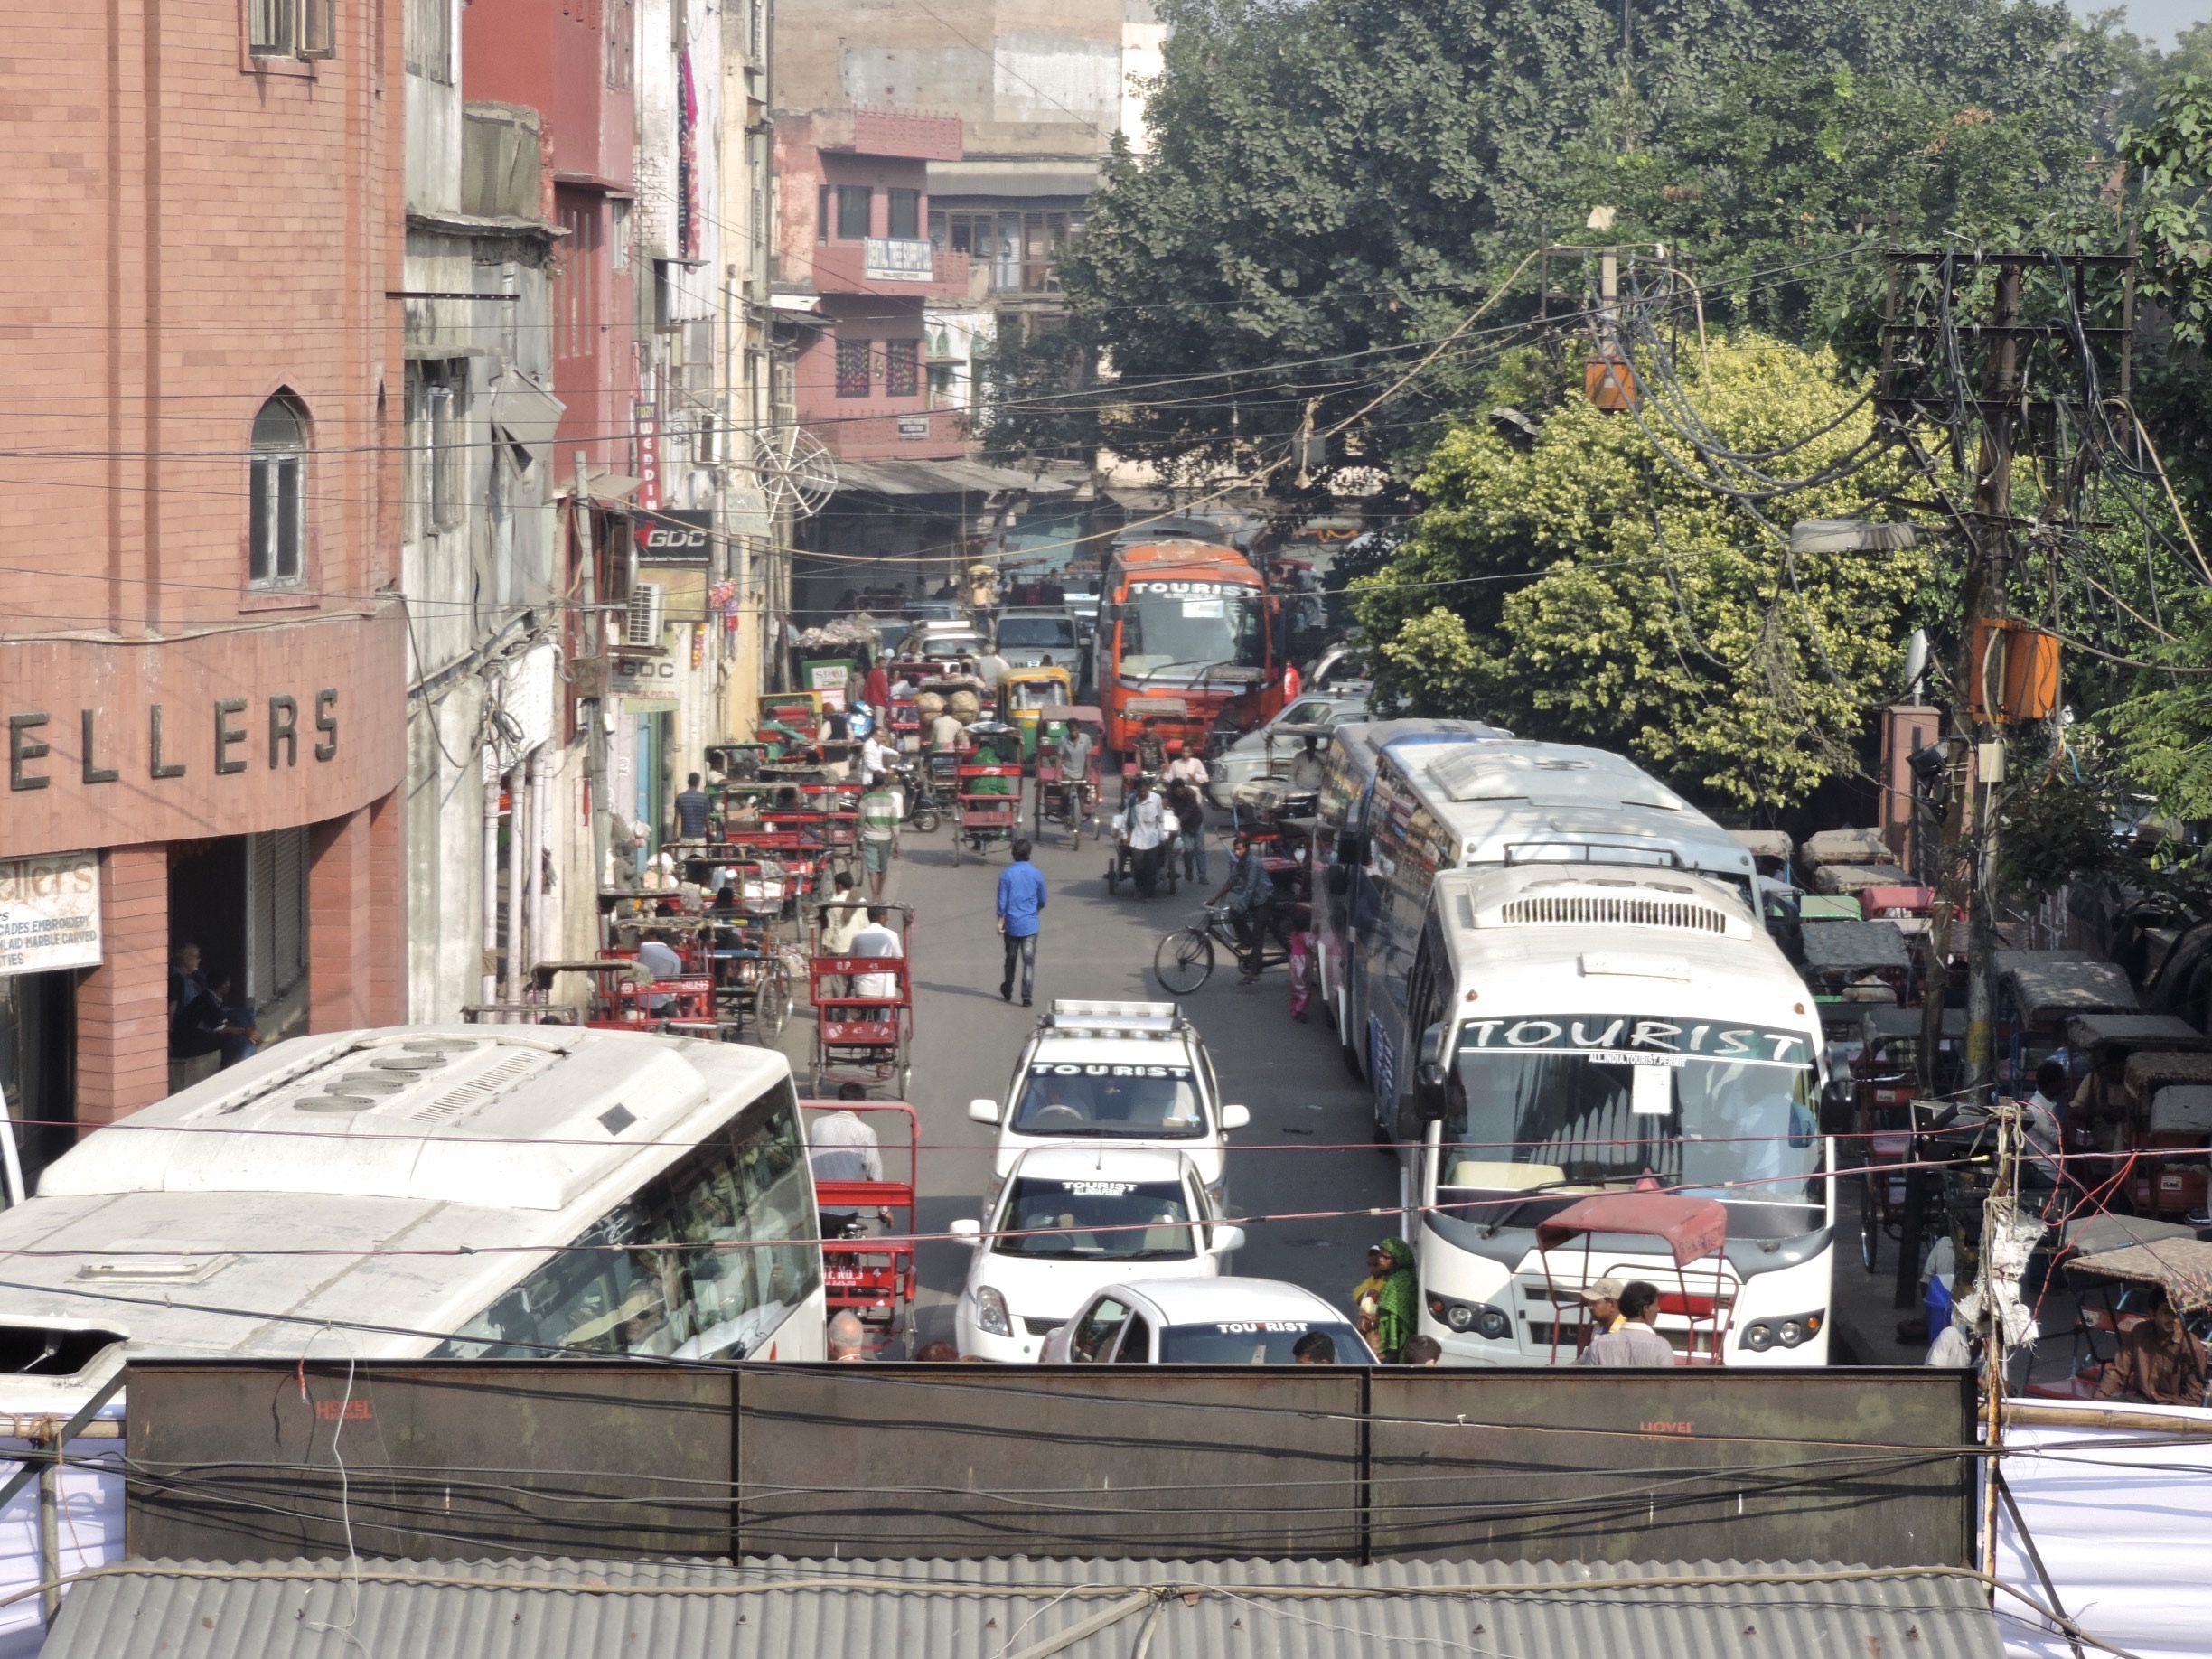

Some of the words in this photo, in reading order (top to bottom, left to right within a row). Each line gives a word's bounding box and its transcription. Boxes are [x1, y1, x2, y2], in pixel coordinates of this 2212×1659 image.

[648, 530, 707, 547] GDC
[1129, 582, 1261, 598] TOURIST
[619, 661, 675, 678] GDC
[10, 688, 338, 791] ELLERS
[1465, 1019, 1803, 1062] TOURIST
[1032, 1064, 1191, 1077] TOURIST
[1063, 1181, 1138, 1191] TOURIST
